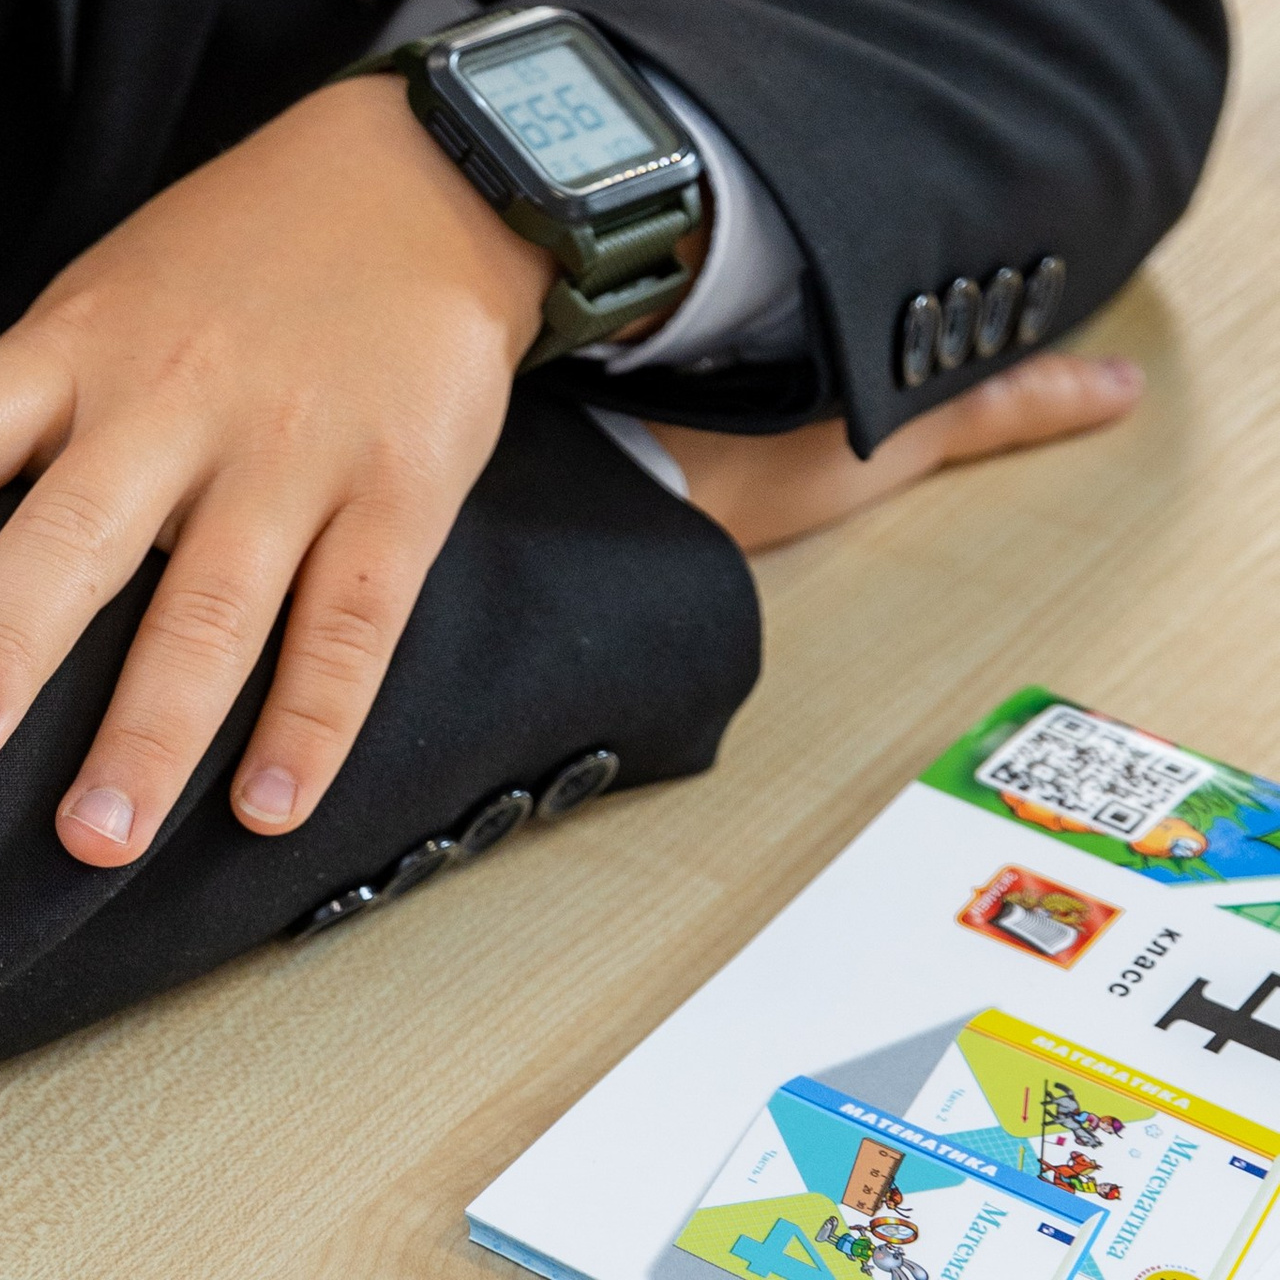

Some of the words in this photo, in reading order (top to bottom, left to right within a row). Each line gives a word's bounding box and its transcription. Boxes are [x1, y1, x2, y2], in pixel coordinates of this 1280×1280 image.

[1108, 928, 1182, 997] класс
[1031, 1035, 1191, 1110] МАТЕМАТИКА
[839, 1103, 999, 1177] МАТЕМАТИКА
[1106, 1135, 1199, 1259] Математика
[729, 1217, 836, 1280] 4
